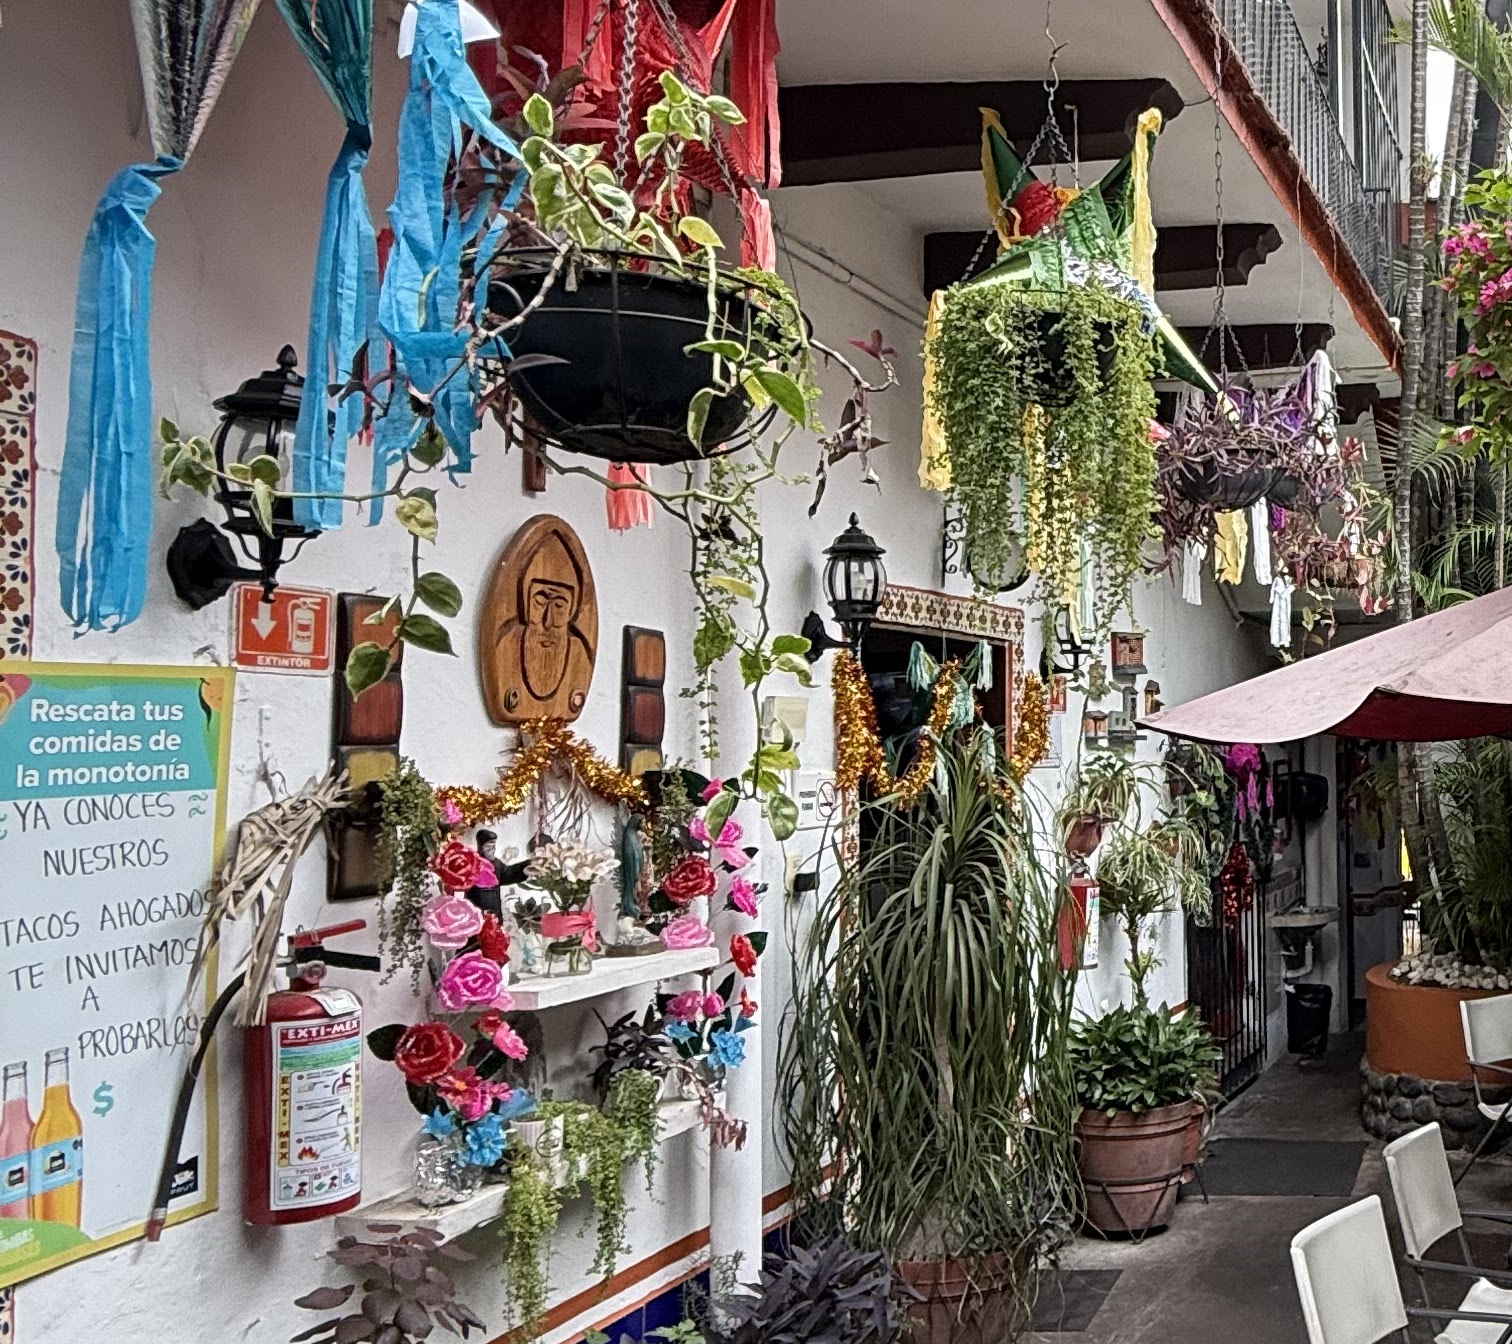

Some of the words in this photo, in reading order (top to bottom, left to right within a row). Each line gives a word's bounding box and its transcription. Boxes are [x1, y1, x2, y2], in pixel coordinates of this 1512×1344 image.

[257, 656, 311, 668] EXTINTOR
[30, 698, 136, 723] Rescata
[143, 700, 184, 722] tus
[29, 728, 143, 755] comidas
[149, 729, 182, 752] de
[16, 763, 40, 788] la
[47, 757, 191, 787] monotonía
[13, 800, 51, 833] YA
[63, 792, 176, 826] CONOCES
[43, 838, 170, 878] NUESTROS
[0, 910, 80, 948] TACOS
[8, 961, 45, 992] TE
[65, 937, 199, 985] INVITAMOS
[81, 985, 100, 1012] A
[92, 1080, 115, 1118] $
